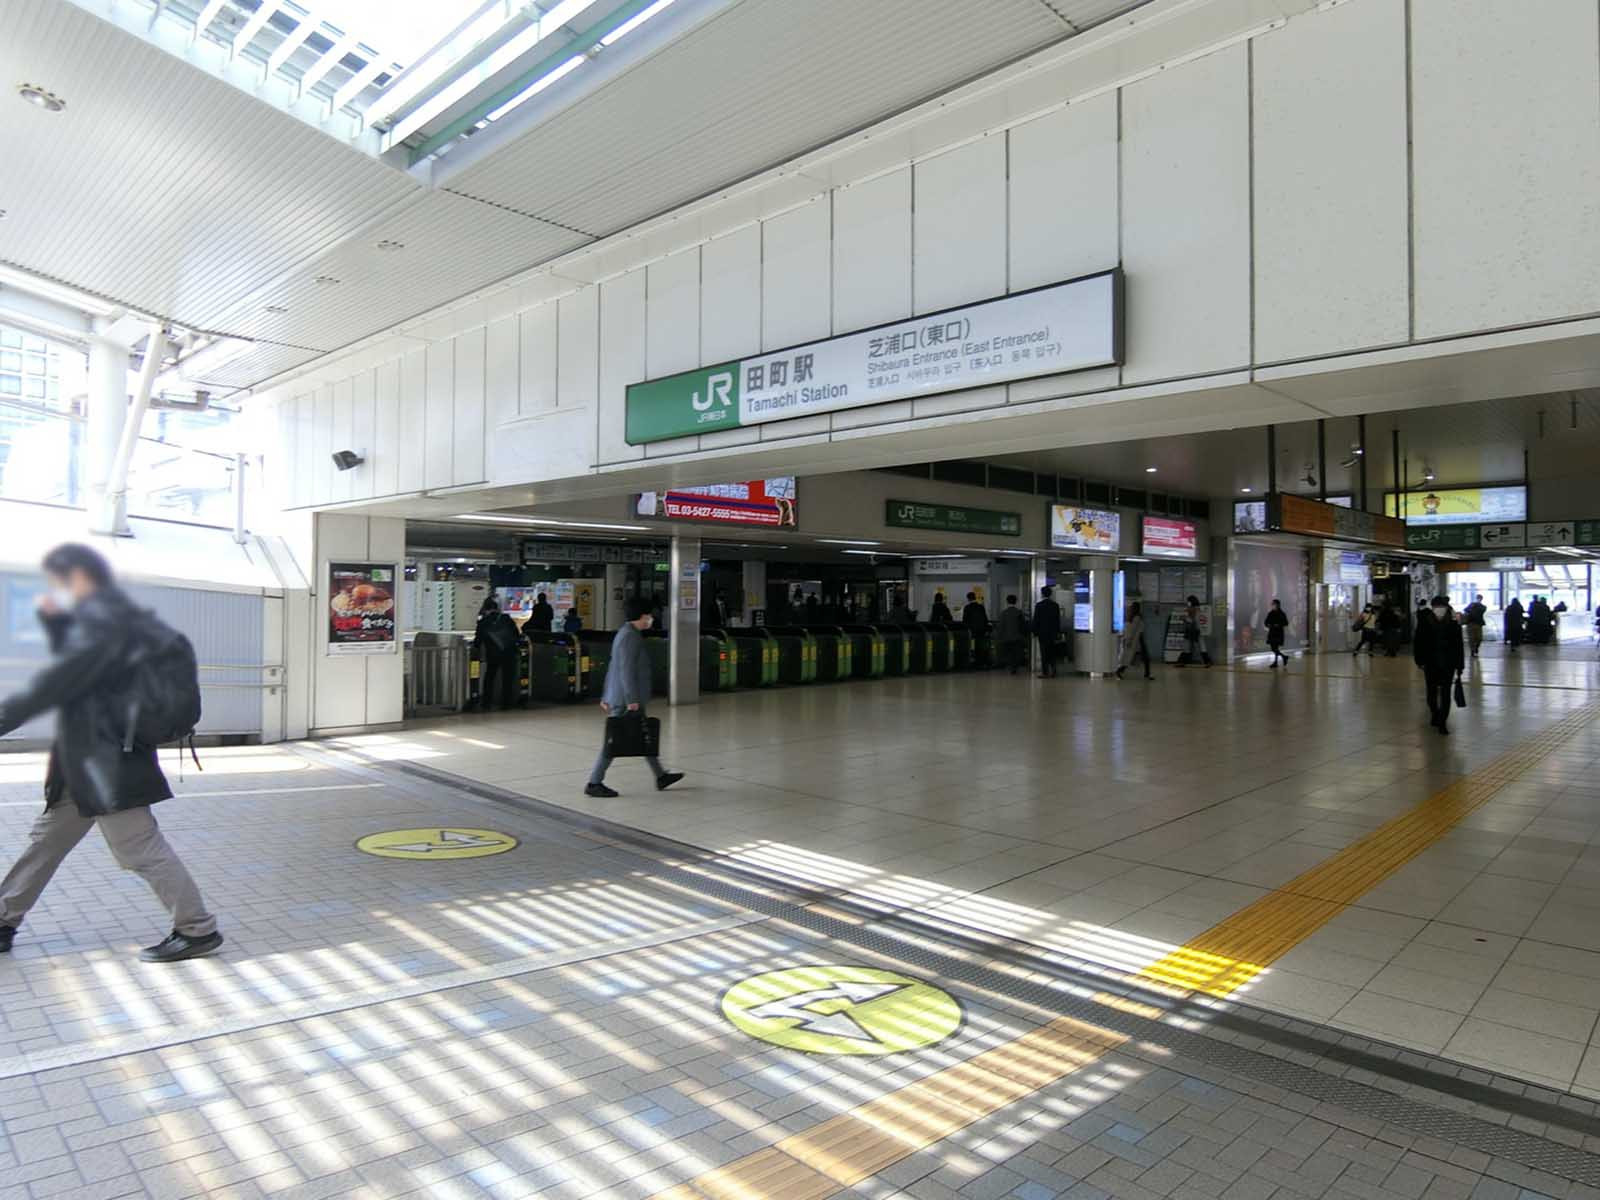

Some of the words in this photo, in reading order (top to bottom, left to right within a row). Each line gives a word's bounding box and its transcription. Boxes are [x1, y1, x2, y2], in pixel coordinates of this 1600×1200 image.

[867, 357, 910, 375] Shibaura
[913, 347, 959, 366] Entrance
[961, 339, 991, 357] (East
[993, 327, 1050, 350] Entrance)
[746, 354, 814, 393] 田町駅
[692, 372, 733, 411] JR
[747, 391, 798, 413] Tamachi
[801, 383, 848, 404] Station
[667, 504, 681, 515] TEL
[898, 504, 915, 520] JR
